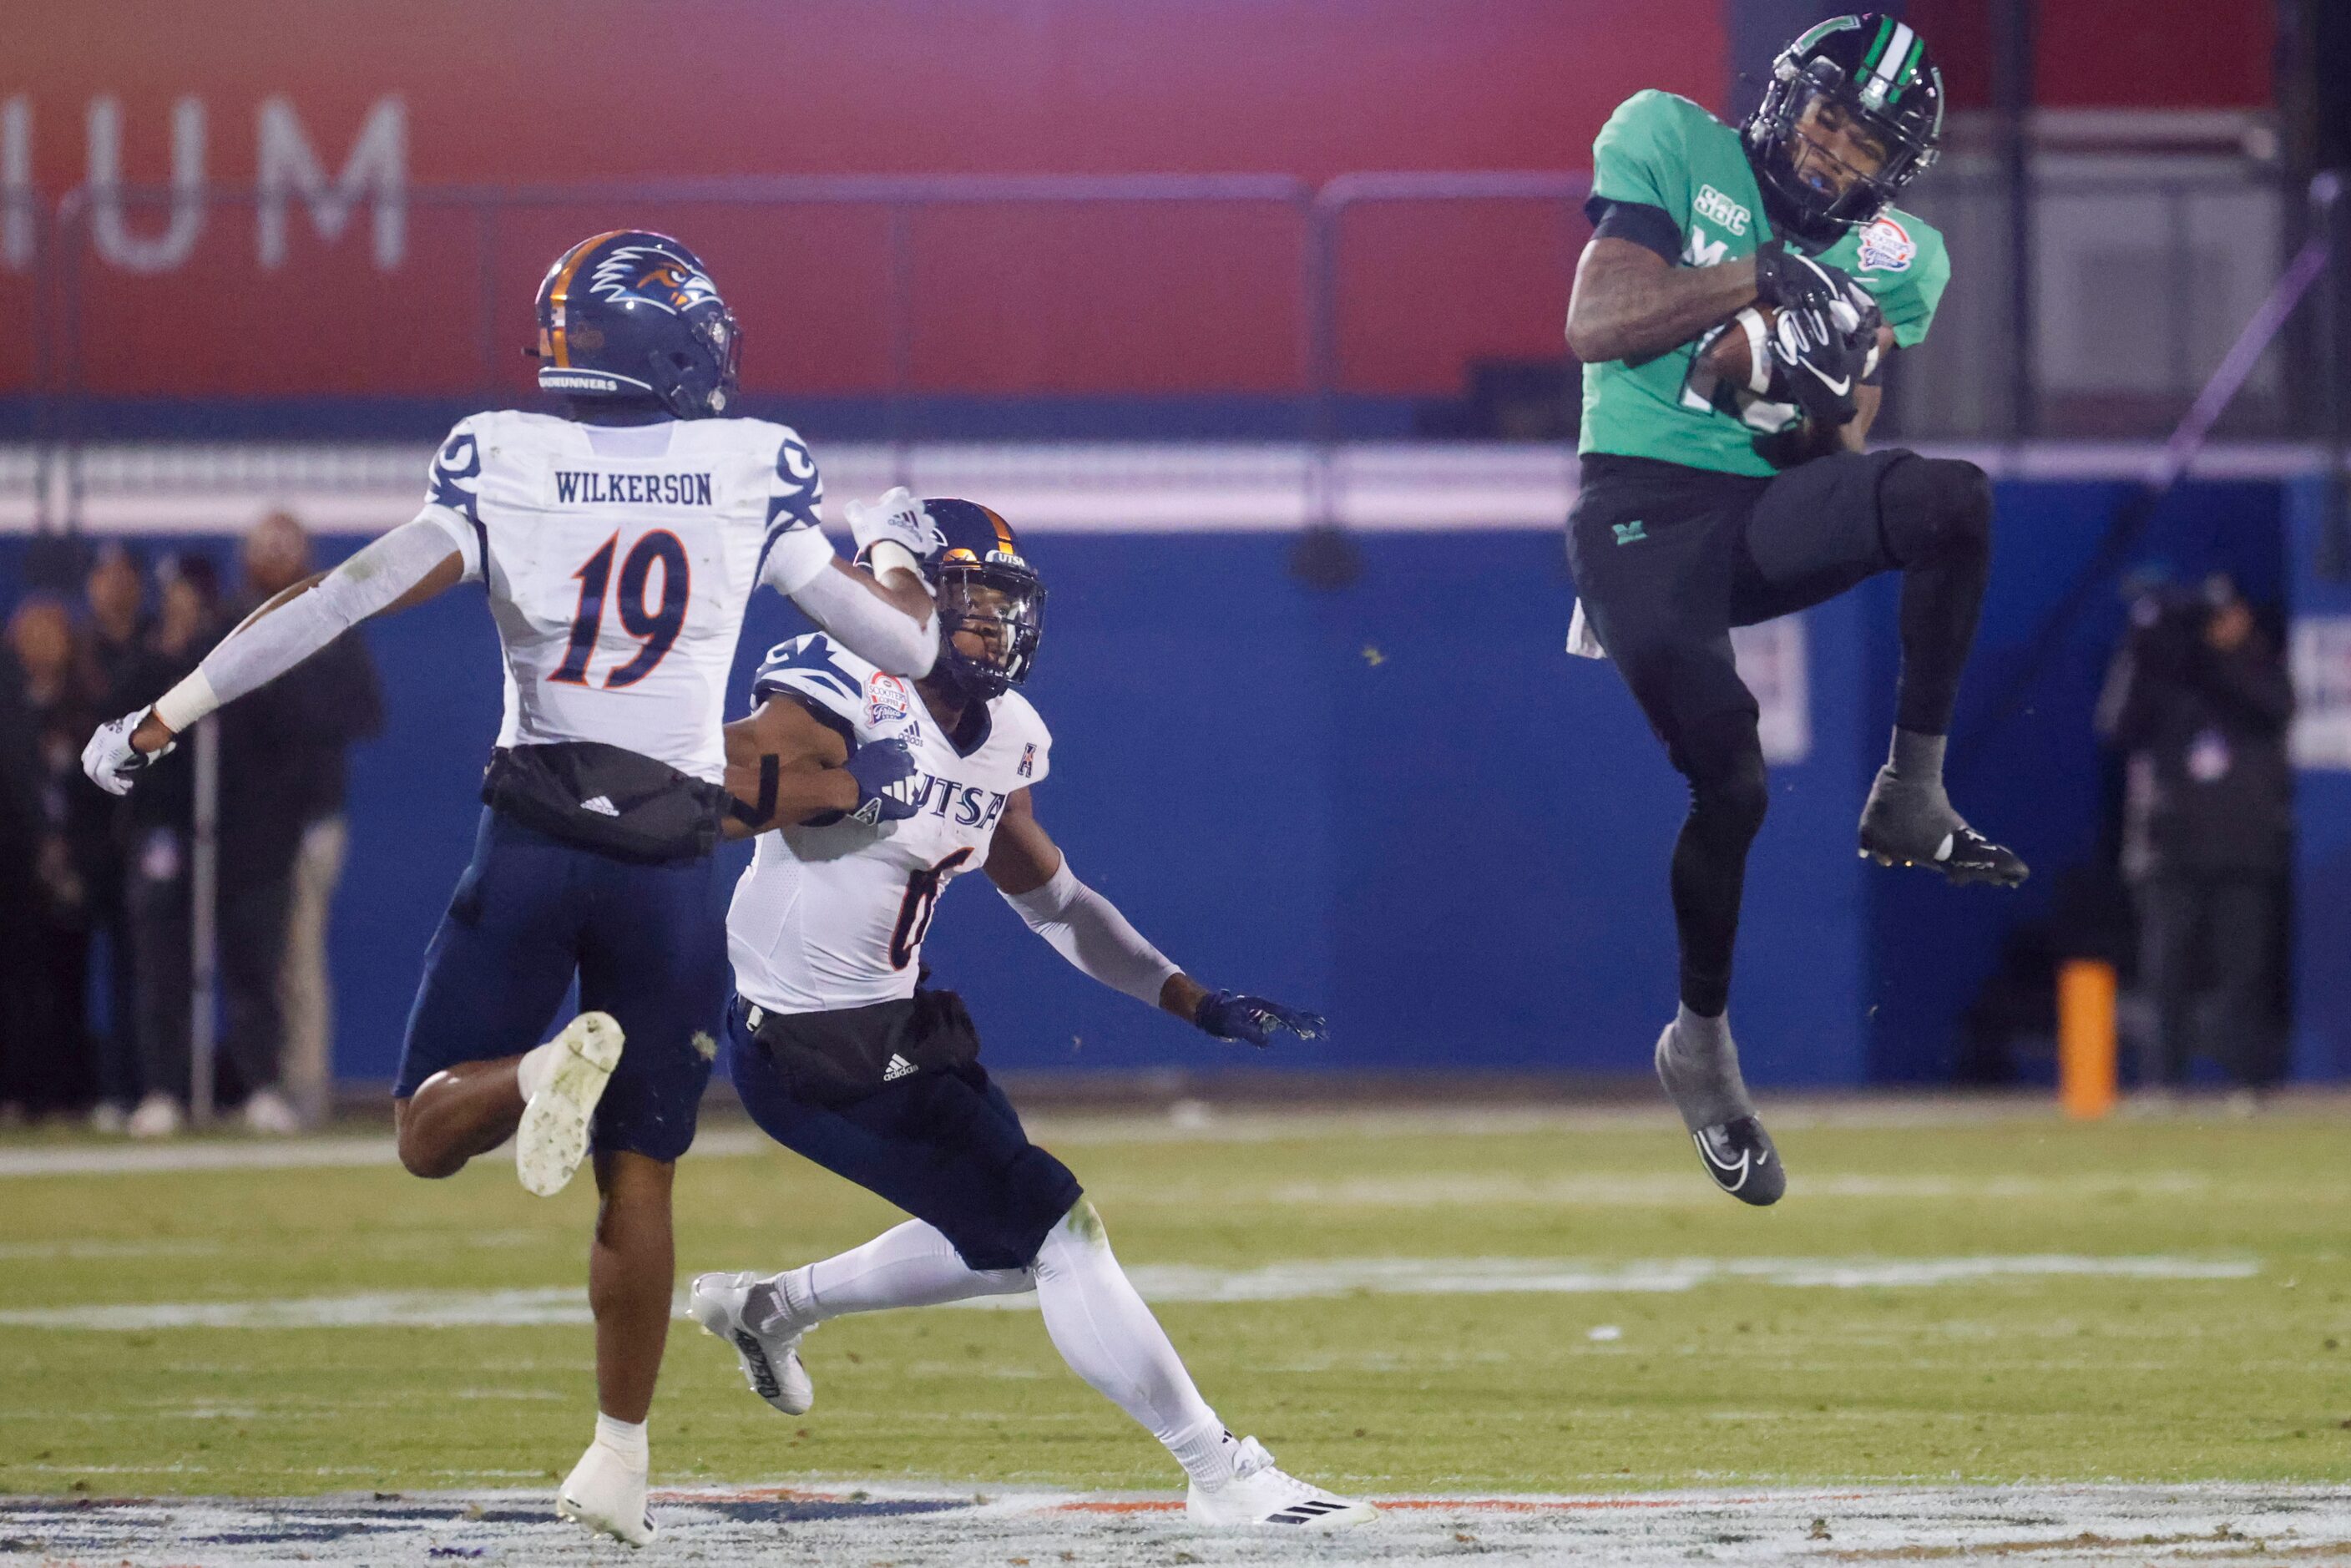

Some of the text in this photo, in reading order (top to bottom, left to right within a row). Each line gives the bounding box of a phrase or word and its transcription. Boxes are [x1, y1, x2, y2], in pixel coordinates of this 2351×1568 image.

[1693, 184, 1752, 237] SBC
[555, 471, 711, 505] WILKERSON
[998, 552, 1026, 568] UTSA
[545, 526, 691, 690] 19
[883, 1065, 919, 1082] adidas
